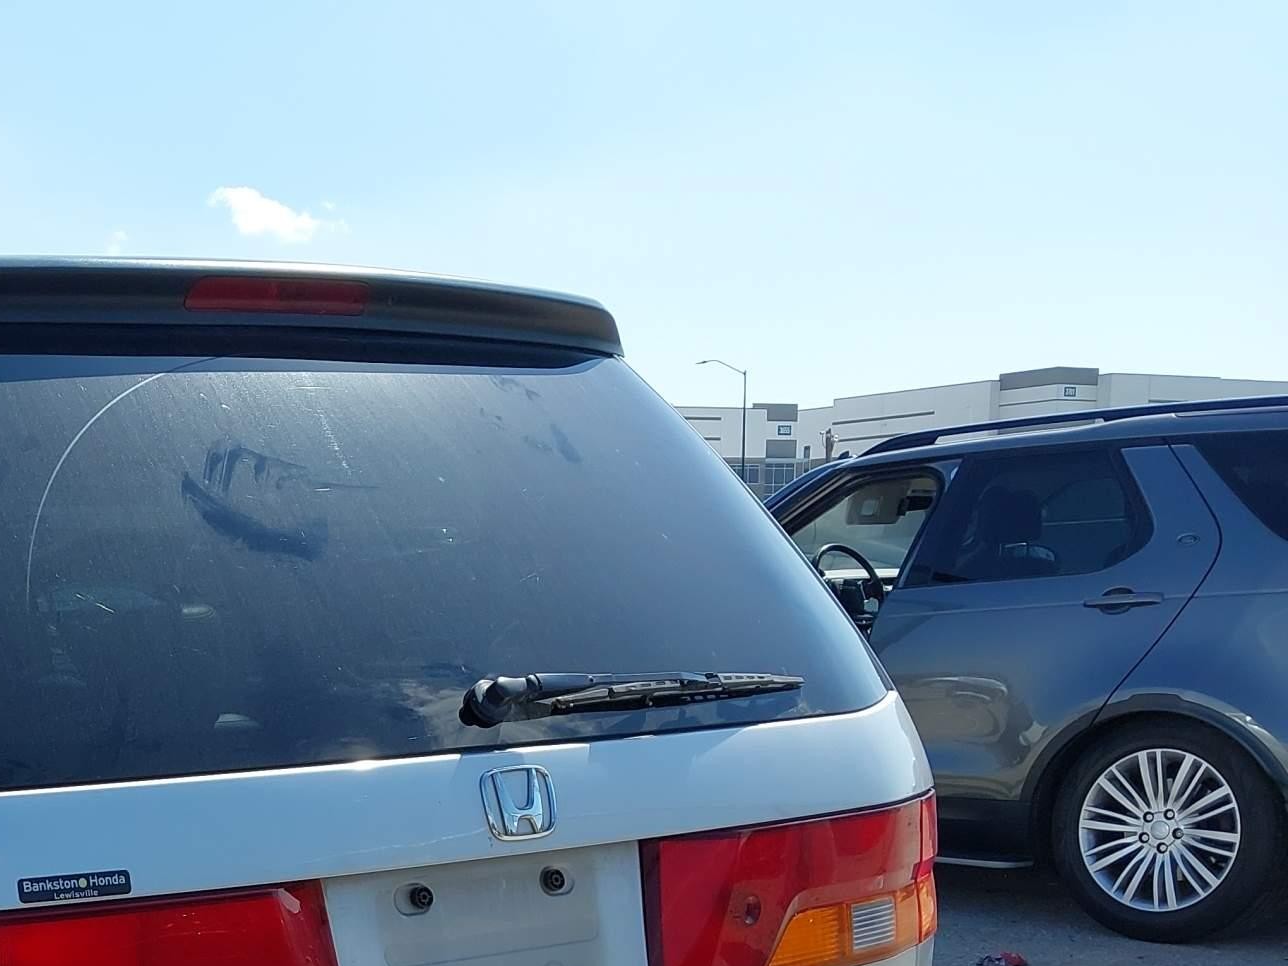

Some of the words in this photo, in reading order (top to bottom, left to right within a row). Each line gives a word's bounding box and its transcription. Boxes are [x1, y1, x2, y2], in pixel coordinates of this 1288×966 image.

[23, 879, 79, 893] Bankston
[89, 874, 126, 887] Honda
[54, 889, 99, 900] Lewisville
